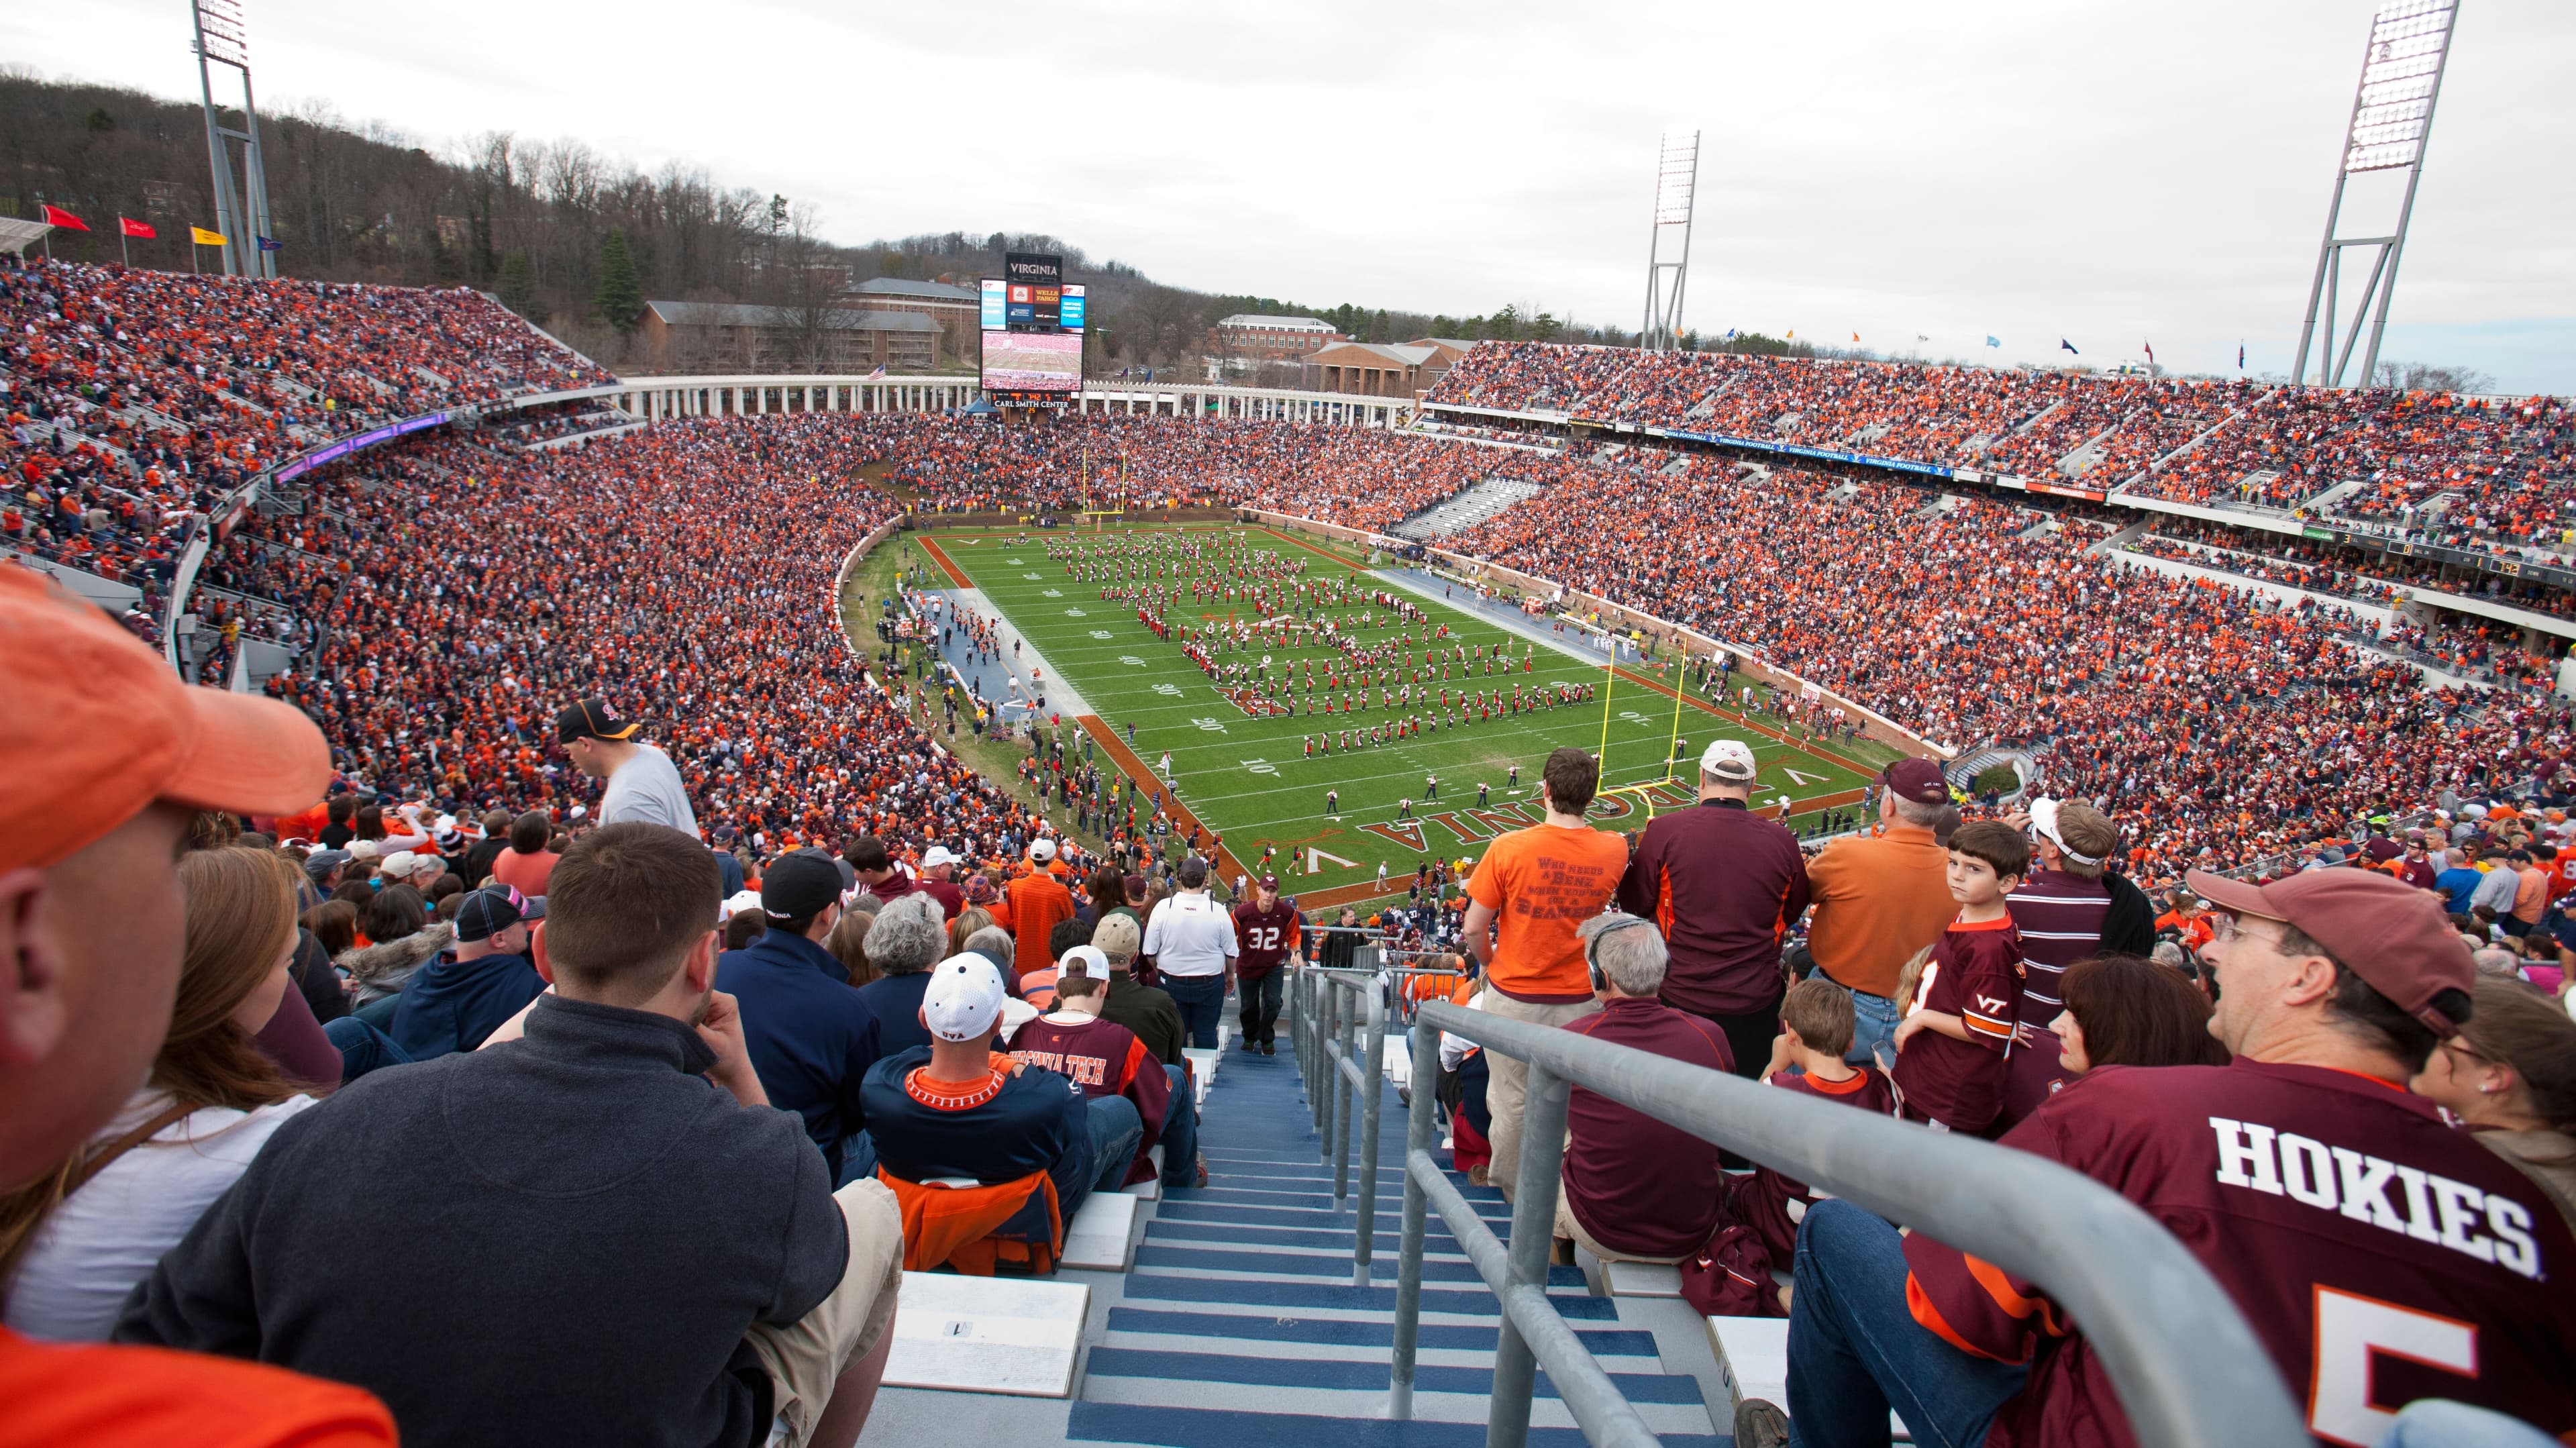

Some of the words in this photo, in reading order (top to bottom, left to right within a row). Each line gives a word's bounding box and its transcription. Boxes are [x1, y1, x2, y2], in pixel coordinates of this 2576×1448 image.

[1010, 262, 1058, 276] VIRGINIA
[1679, 432, 1707, 441] FOOTBALL
[1719, 437, 1745, 446] VIRGINIA
[1745, 441, 1775, 450] FOOTBALL
[1789, 447, 1816, 456] VIRGINIA
[1816, 451, 1849, 460] FOOTBALL
[1865, 458, 1896, 467] VIRGINIA
[1896, 462, 1931, 472] FOOTBALL
[2050, 486, 2085, 498] McDonald's
[2343, 534, 2352, 544] 3
[1088, 630, 1113, 639] 50
[1118, 655, 1145, 666] 40
[1151, 683, 1181, 695] 30
[1190, 717, 1225, 731] 20
[1618, 711, 1653, 724] 10
[1240, 758, 1276, 774] 10
[1538, 857, 1565, 870] WHO
[1567, 864, 1604, 875] NEEDS
[1542, 872, 1549, 880] A
[1551, 871, 1595, 887] BENZ
[1527, 886, 1559, 896] WHEN
[1548, 896, 1567, 904] GOT
[766, 909, 791, 919] VIRGINIA
[1409, 910, 1417, 919] 37
[1249, 927, 1280, 951] 32
[1976, 993, 2008, 1016] VT
[942, 1030, 966, 1039] UVA
[1066, 1055, 1107, 1086] TECH
[2209, 1117, 2543, 1278] HOKIES
[2305, 1282, 2479, 1448] 5
